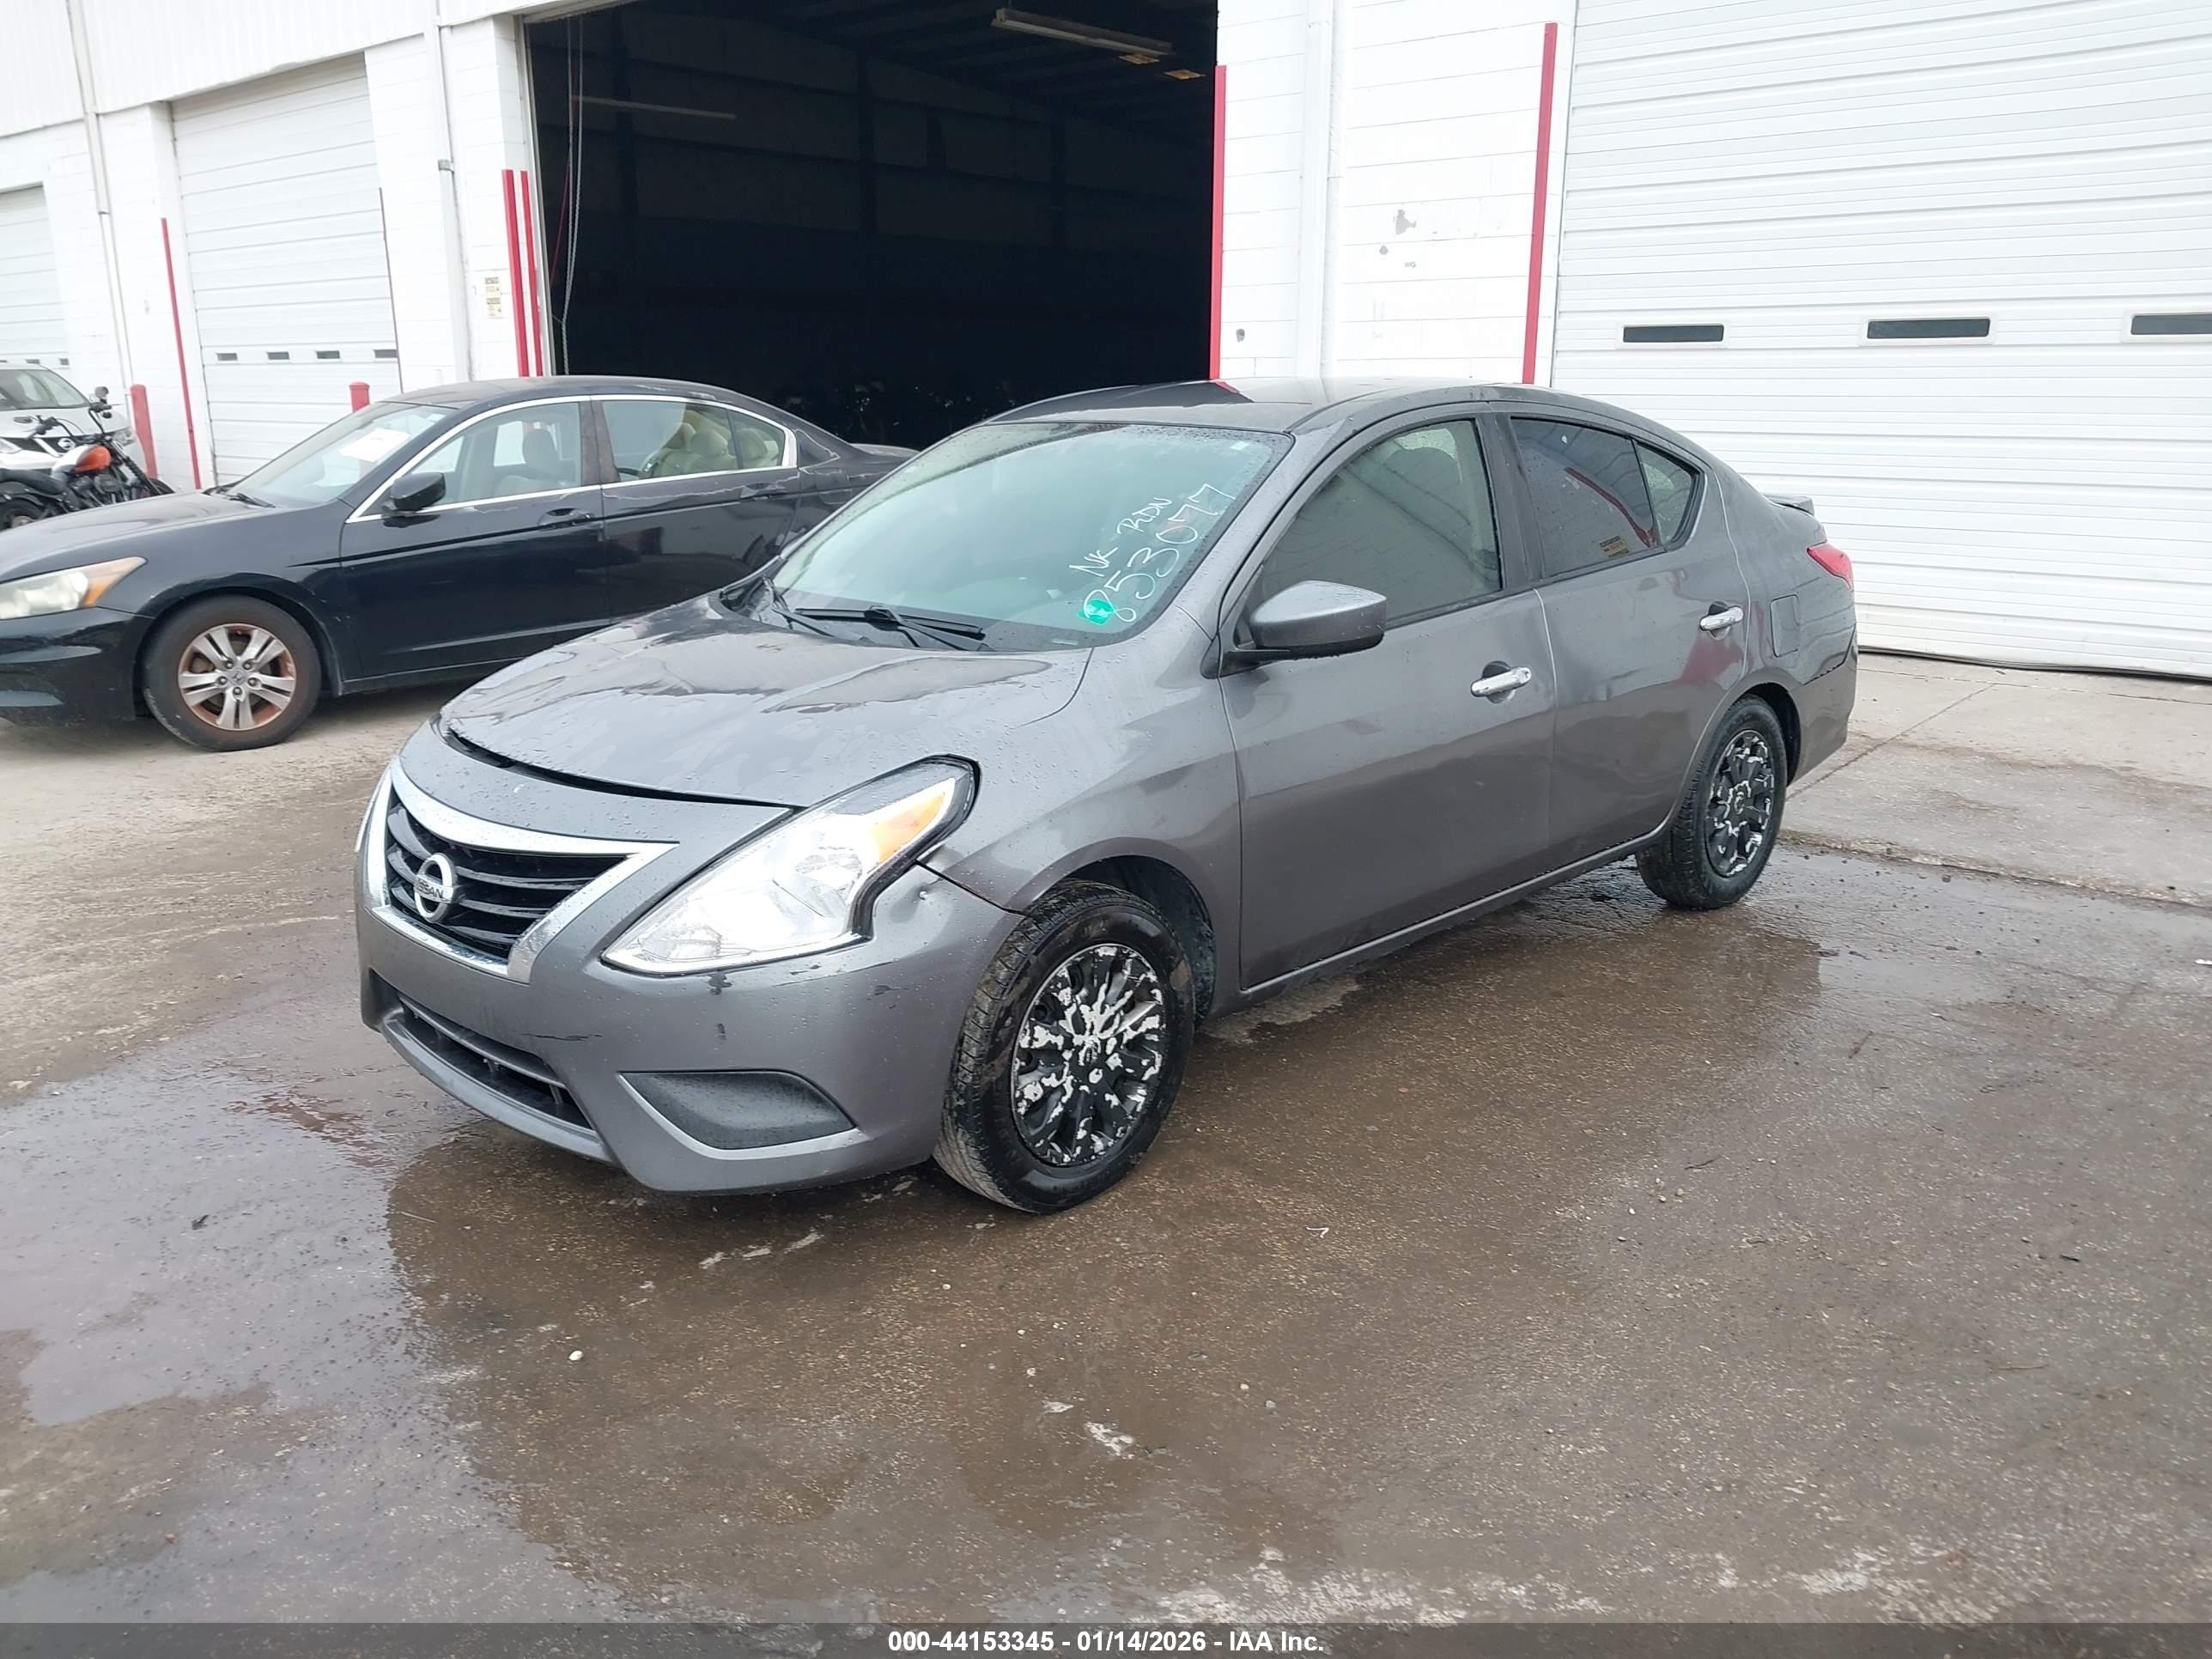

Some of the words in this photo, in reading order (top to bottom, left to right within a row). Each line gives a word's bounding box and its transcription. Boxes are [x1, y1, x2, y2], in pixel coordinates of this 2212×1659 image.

[1068, 547, 1119, 577] NK
[1083, 483, 1236, 622] 853077
[416, 877, 444, 899] SSAN
